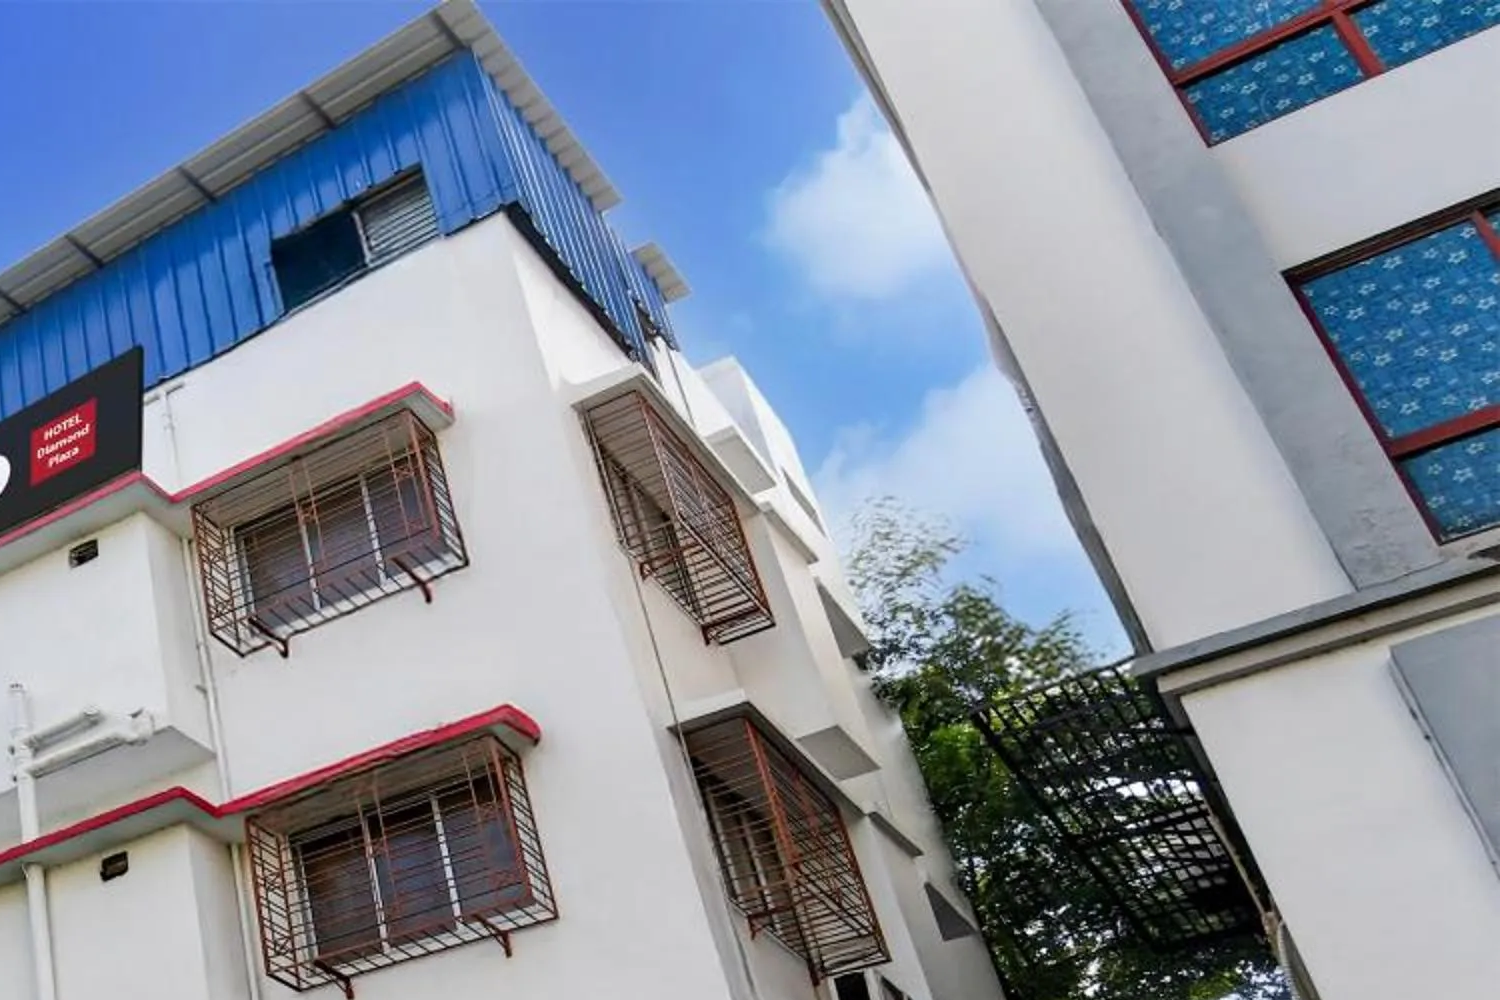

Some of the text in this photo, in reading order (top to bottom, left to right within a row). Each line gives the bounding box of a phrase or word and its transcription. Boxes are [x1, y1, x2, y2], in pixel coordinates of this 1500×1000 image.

[43, 412, 83, 440] HOTEL
[37, 423, 90, 459] Diamond
[48, 446, 80, 468] Plaza
